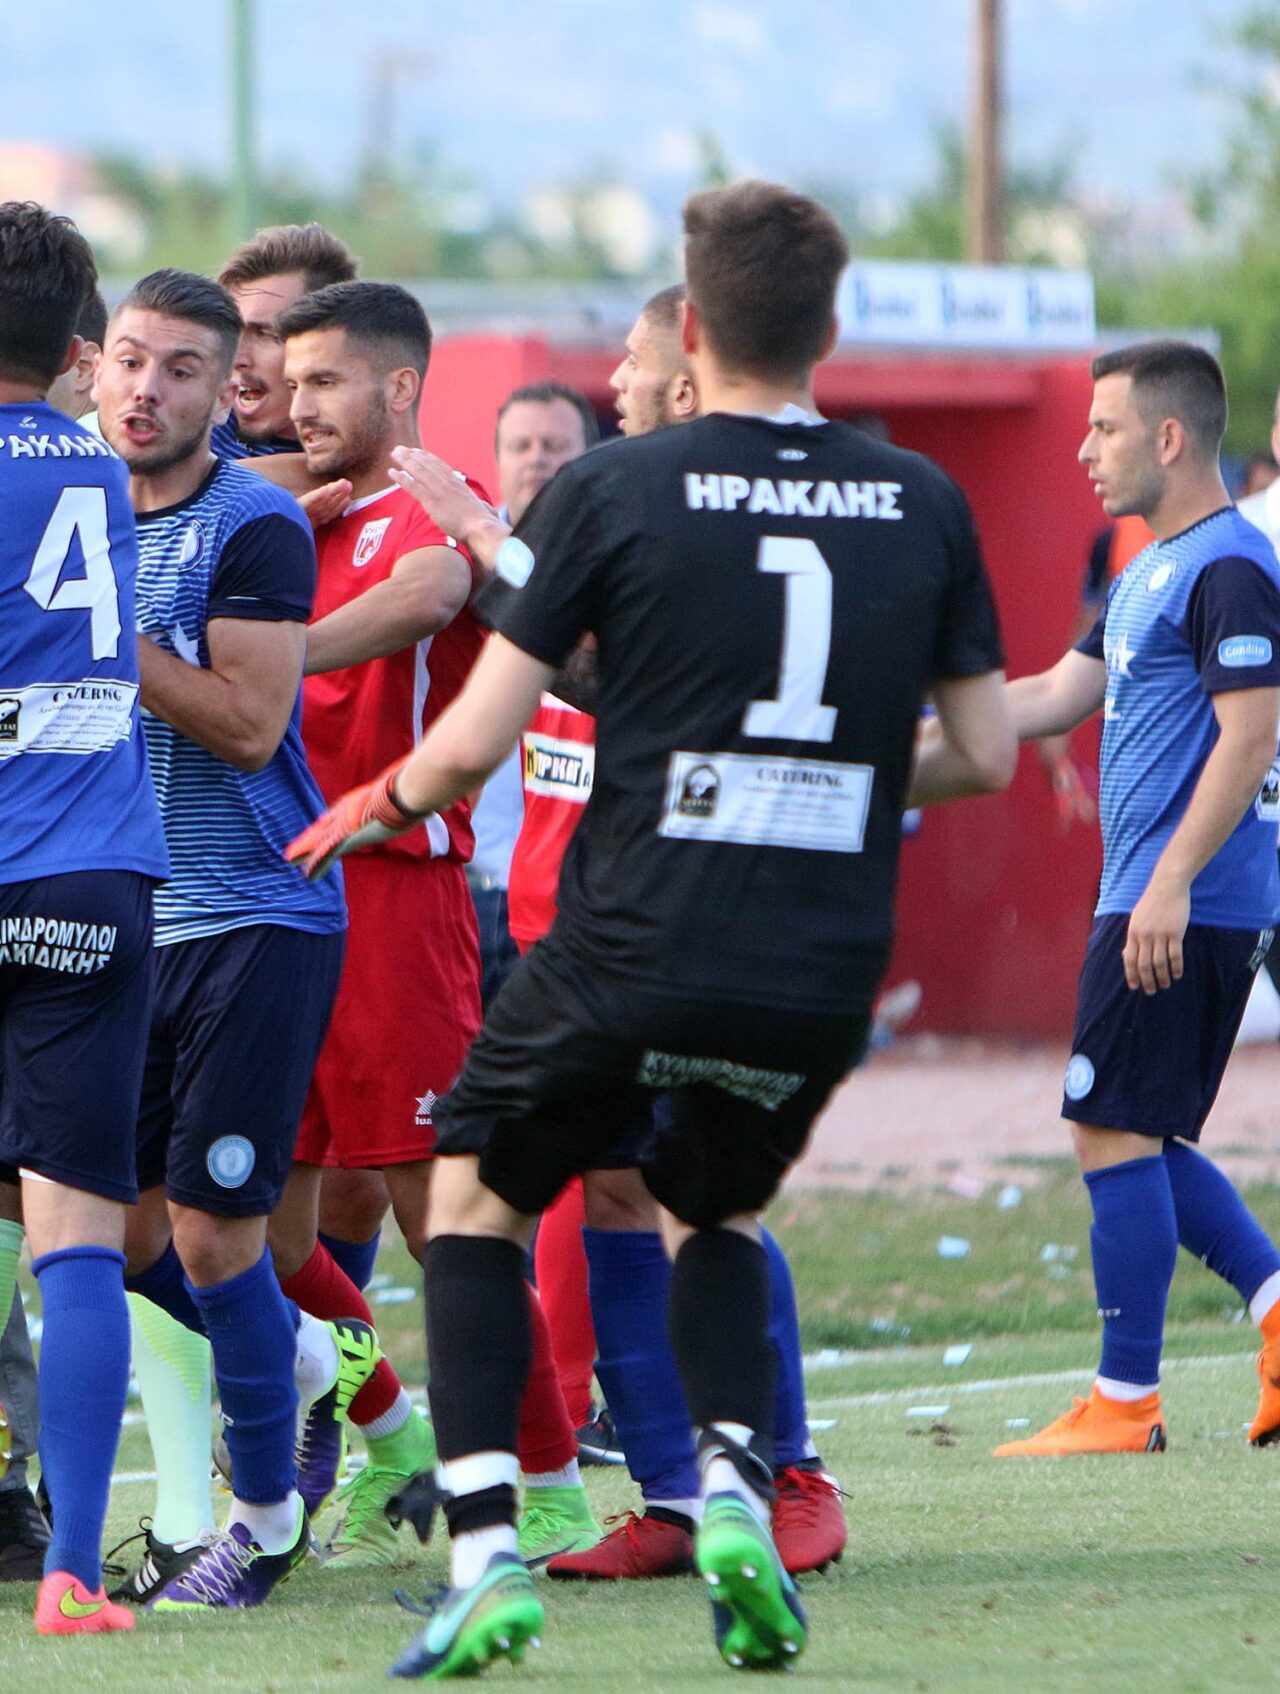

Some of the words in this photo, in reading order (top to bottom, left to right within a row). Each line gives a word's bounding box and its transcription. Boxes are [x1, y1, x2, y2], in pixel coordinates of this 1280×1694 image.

[685, 473, 903, 520] ΗΡΑΚΛΗΣ
[23, 486, 122, 661] 4
[741, 535, 838, 742] 1
[757, 767, 843, 788] CATERING
[333, 1321, 373, 1424] NIKE
